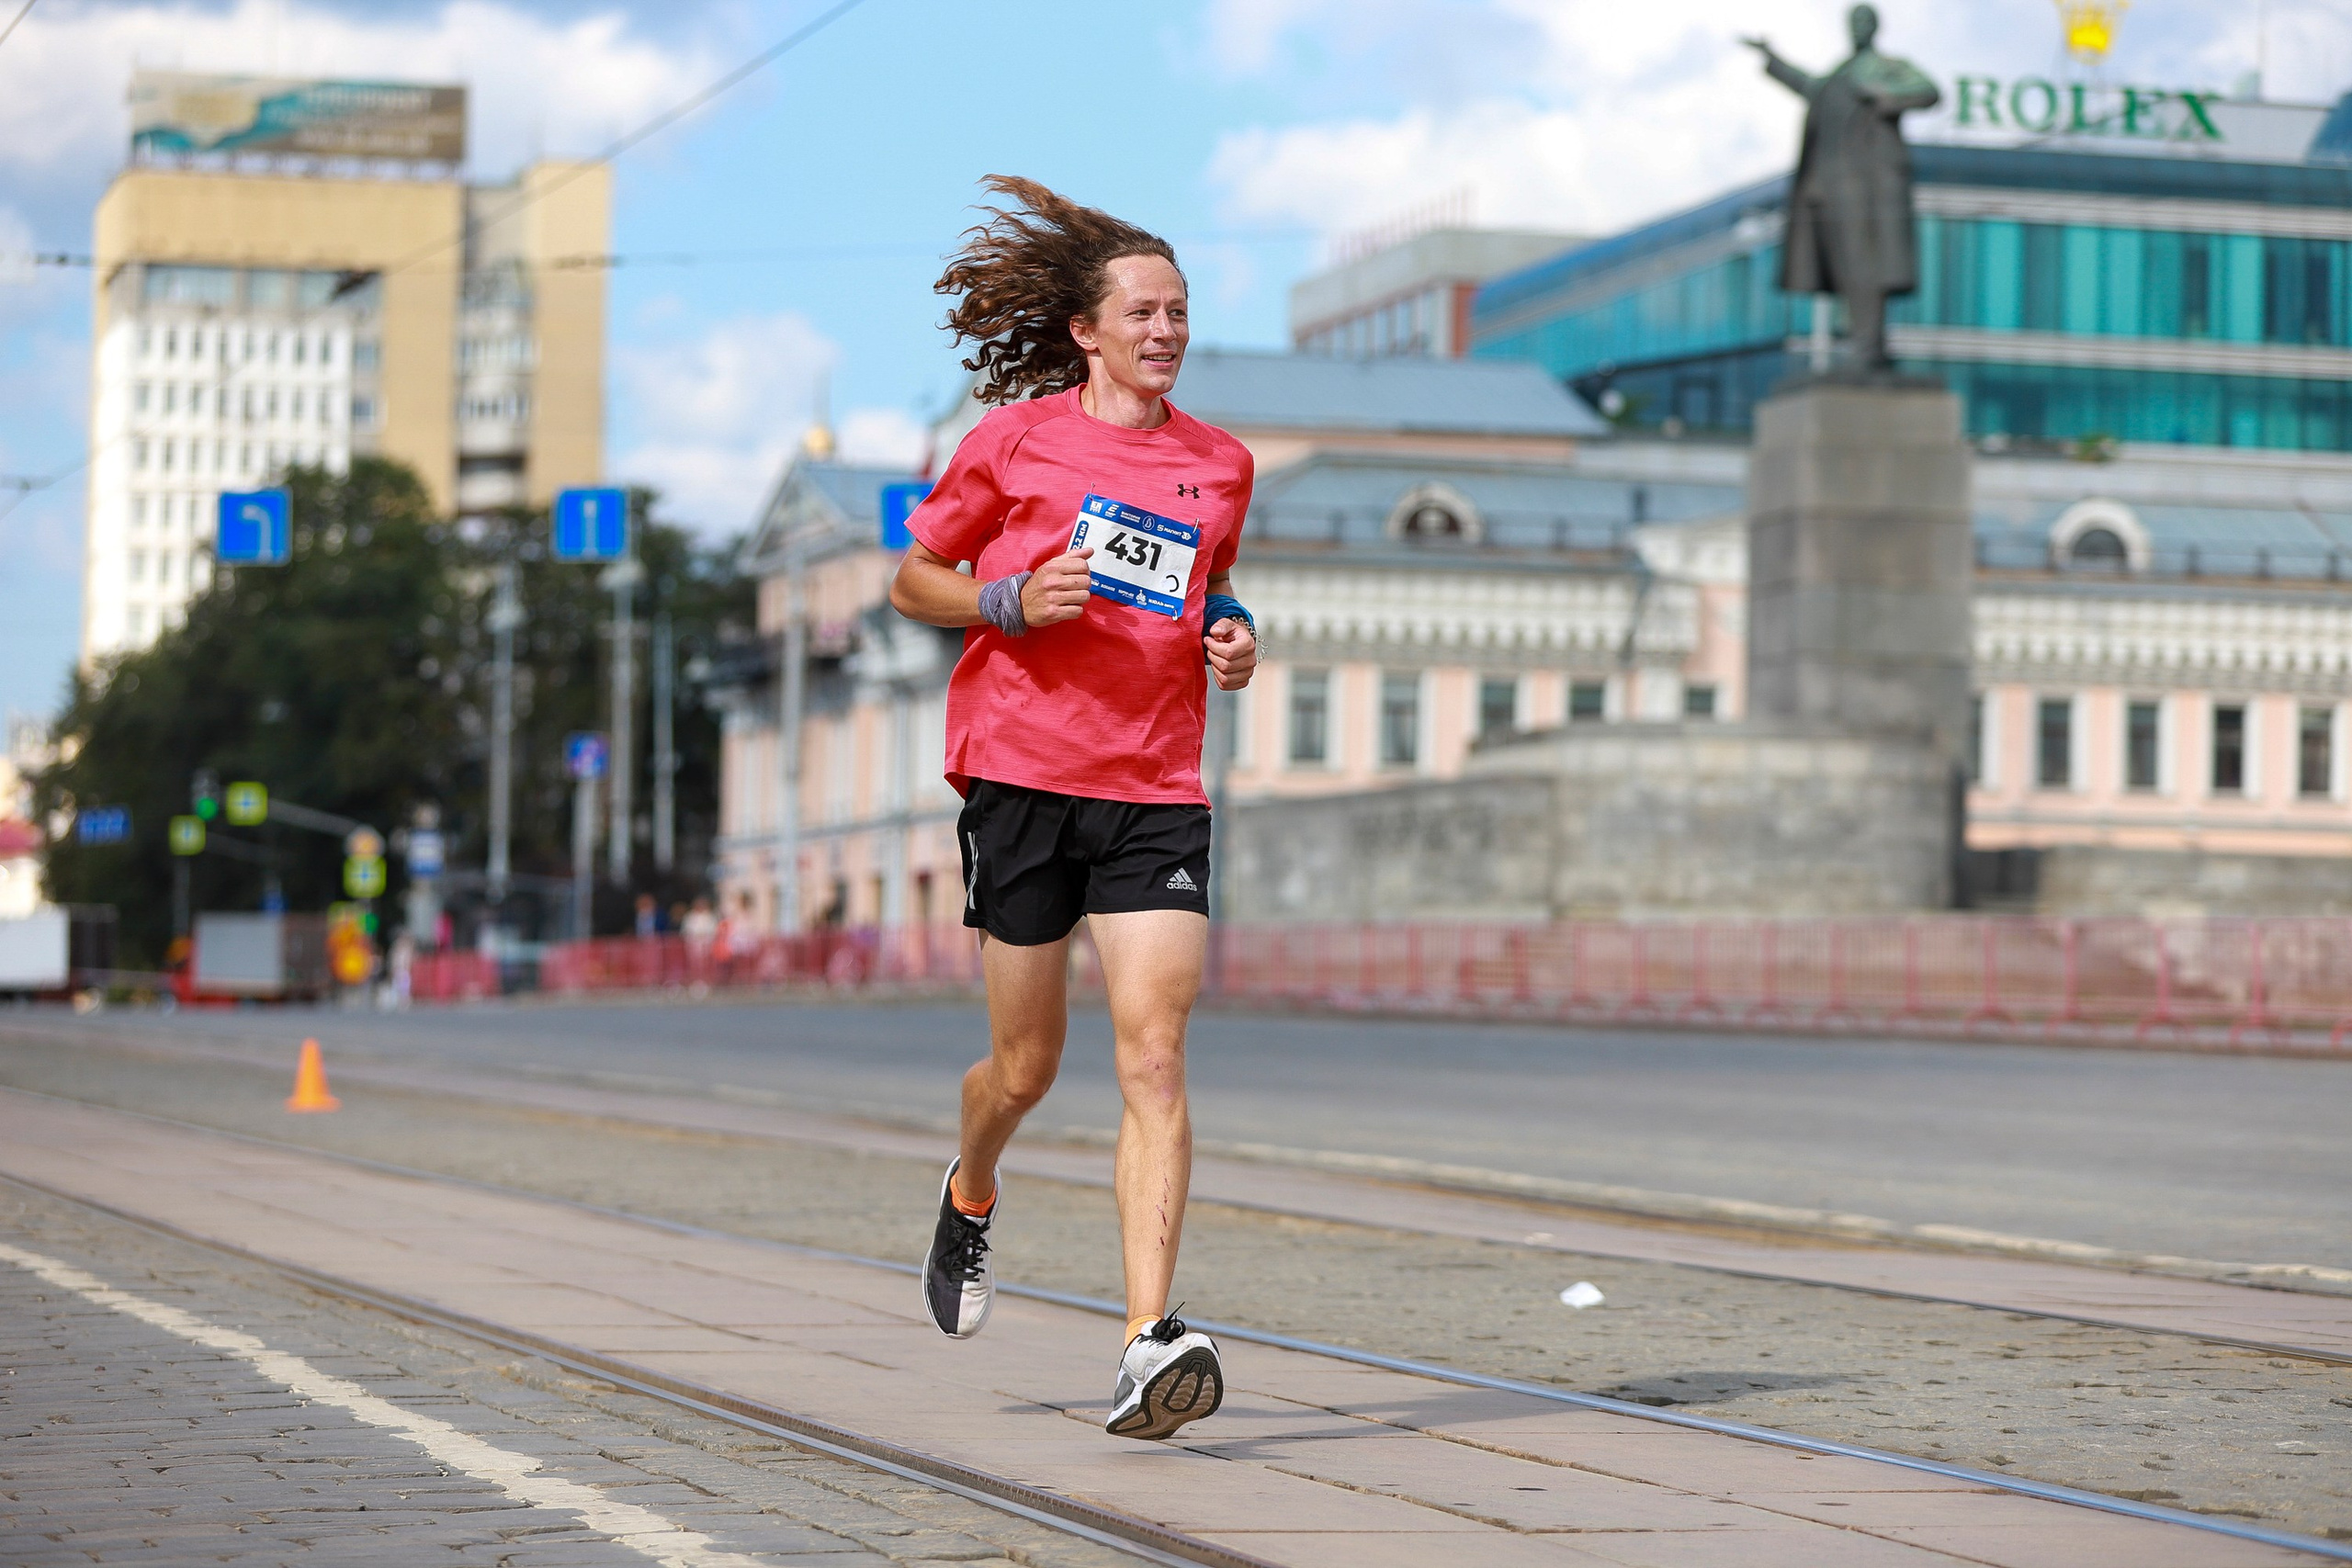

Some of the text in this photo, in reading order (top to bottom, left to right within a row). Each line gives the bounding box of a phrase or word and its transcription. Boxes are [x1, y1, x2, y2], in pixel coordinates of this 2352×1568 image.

[1956, 76, 2223, 140] ROLEX
[1104, 532, 1163, 571] 431
[1166, 882, 1198, 891] adidas
